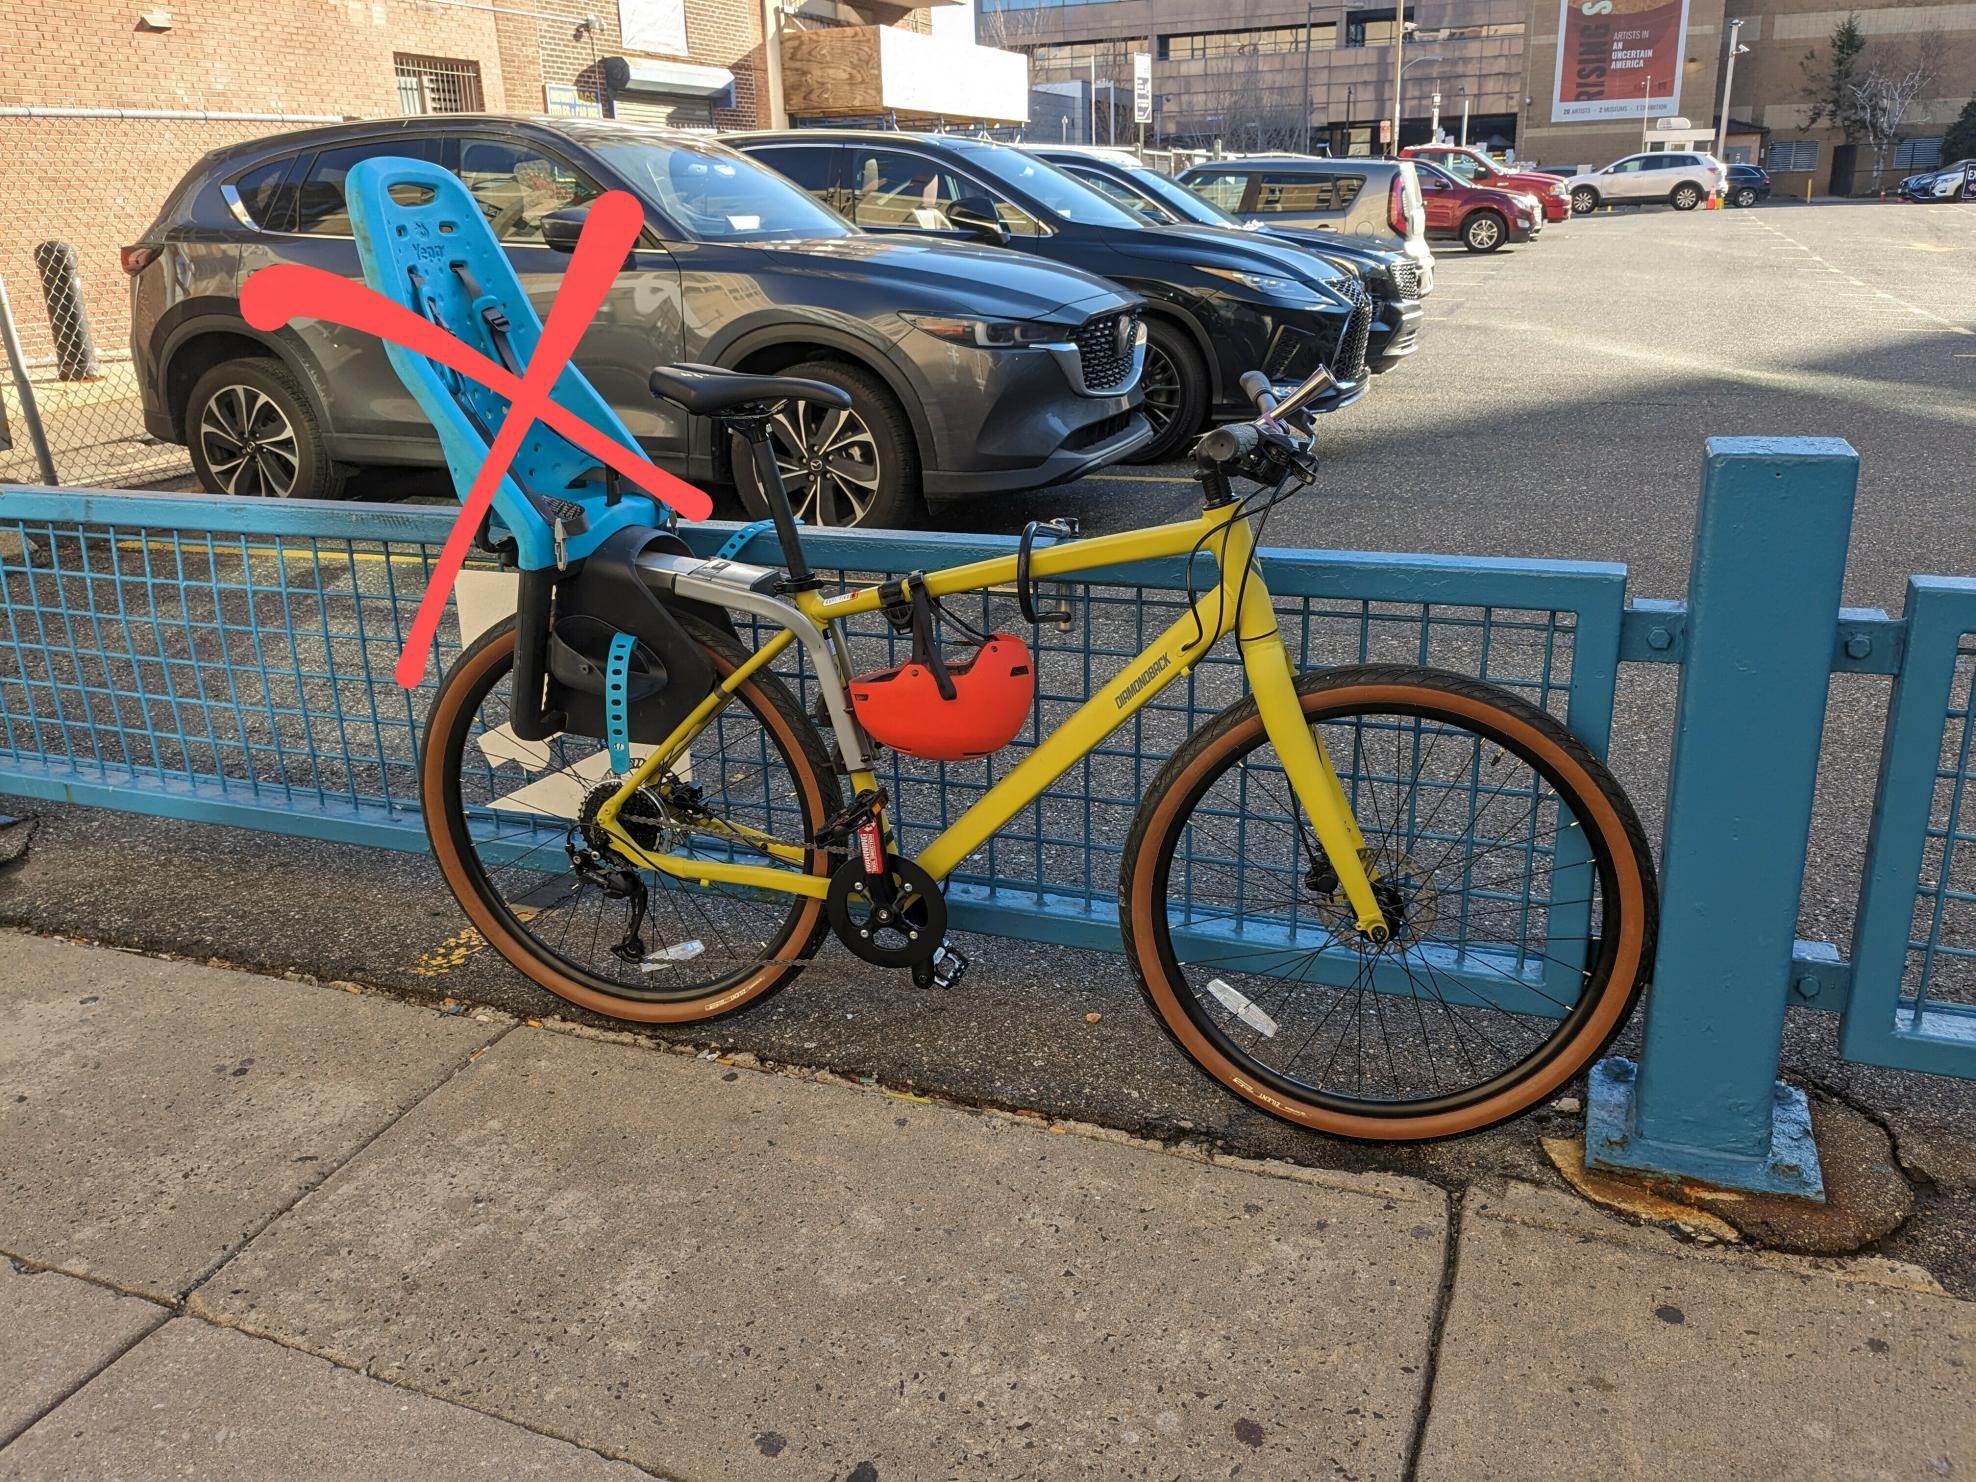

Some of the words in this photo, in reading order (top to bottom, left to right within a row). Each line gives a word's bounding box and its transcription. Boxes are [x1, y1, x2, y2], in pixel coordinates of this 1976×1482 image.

[1613, 31, 1640, 40] ARTISTS
[1641, 30, 1649, 39] IN
[1612, 41, 1623, 50] AN
[1611, 49, 1653, 60] UNCERTAIN
[1575, 25, 1610, 101] RISING
[1611, 59, 1644, 69] AMERICA
[1115, 652, 1171, 710] DIAMONDBACK
[860, 833, 871, 872] WARNING
[1259, 1093, 1281, 1109] ZILENT
